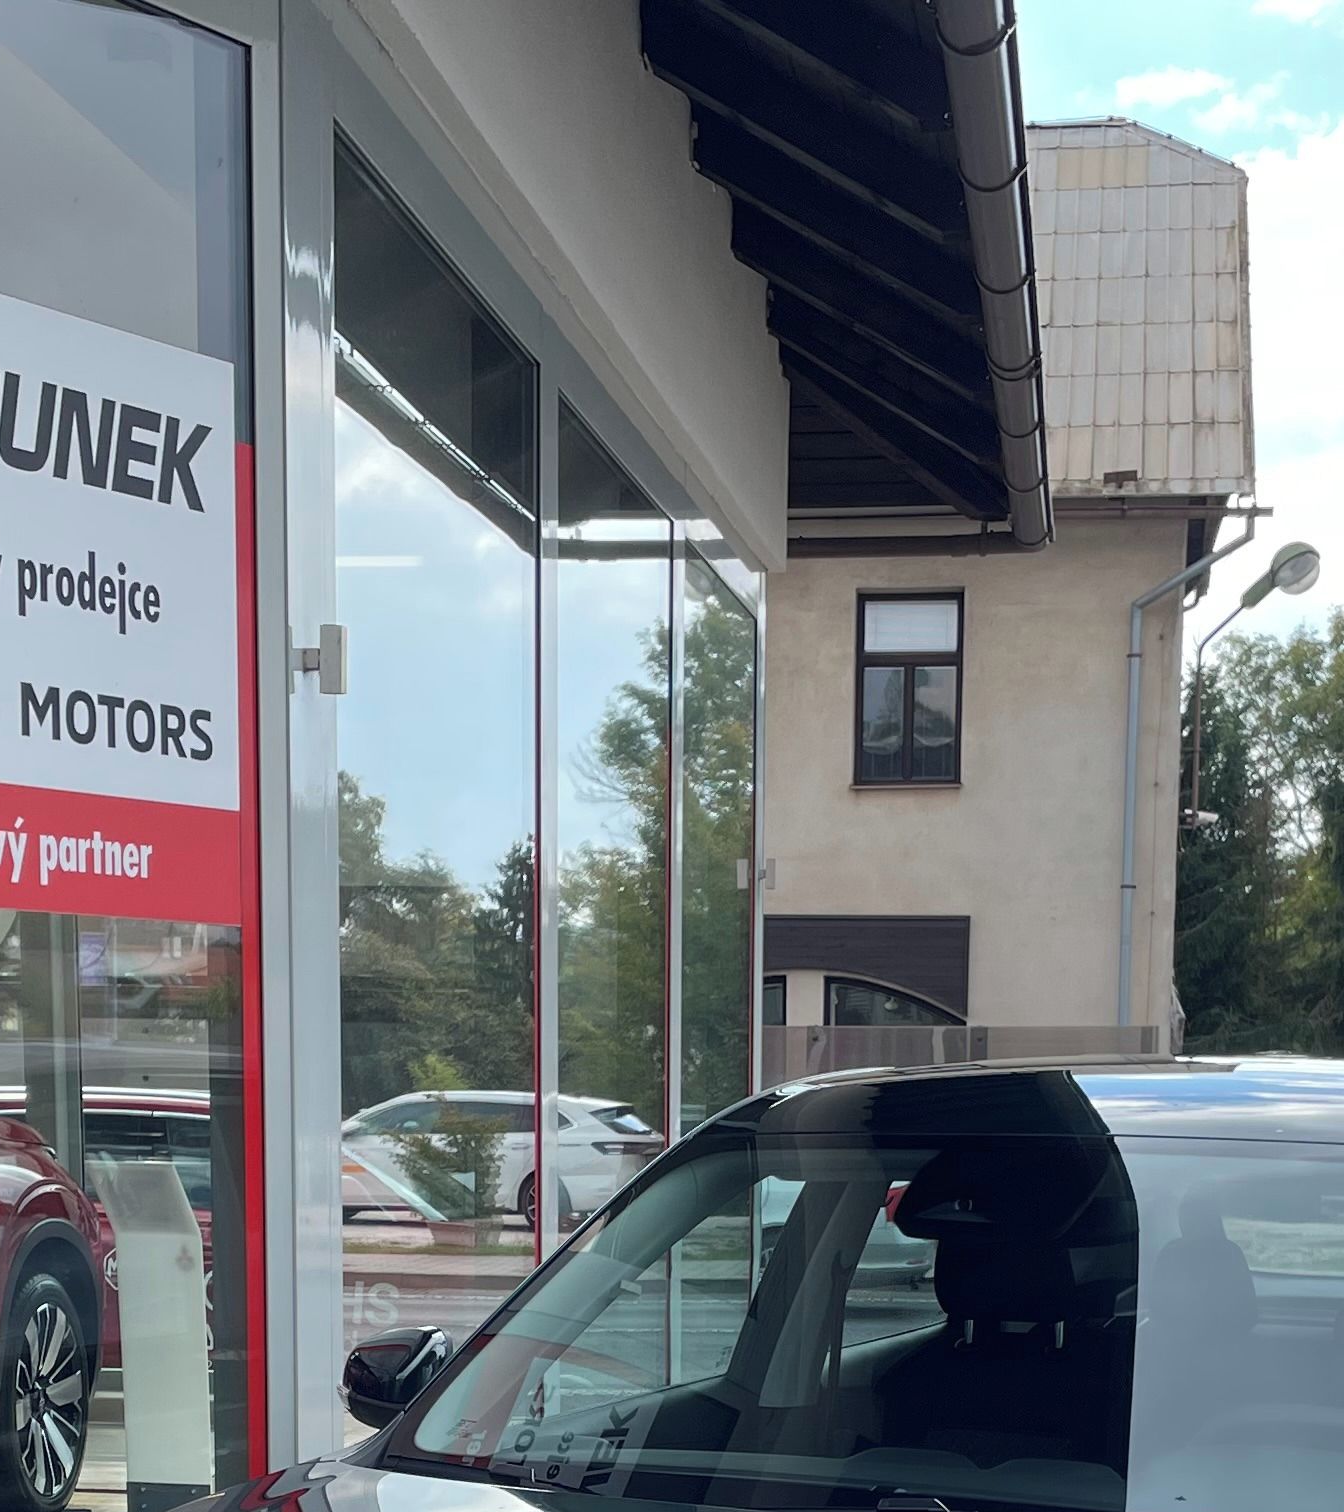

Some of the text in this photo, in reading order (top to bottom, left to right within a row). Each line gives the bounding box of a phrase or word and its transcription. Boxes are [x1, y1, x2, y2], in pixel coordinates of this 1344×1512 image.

[17, 550, 162, 635] prodejce
[20, 681, 214, 761] MOTORS
[39, 831, 154, 886] partner
